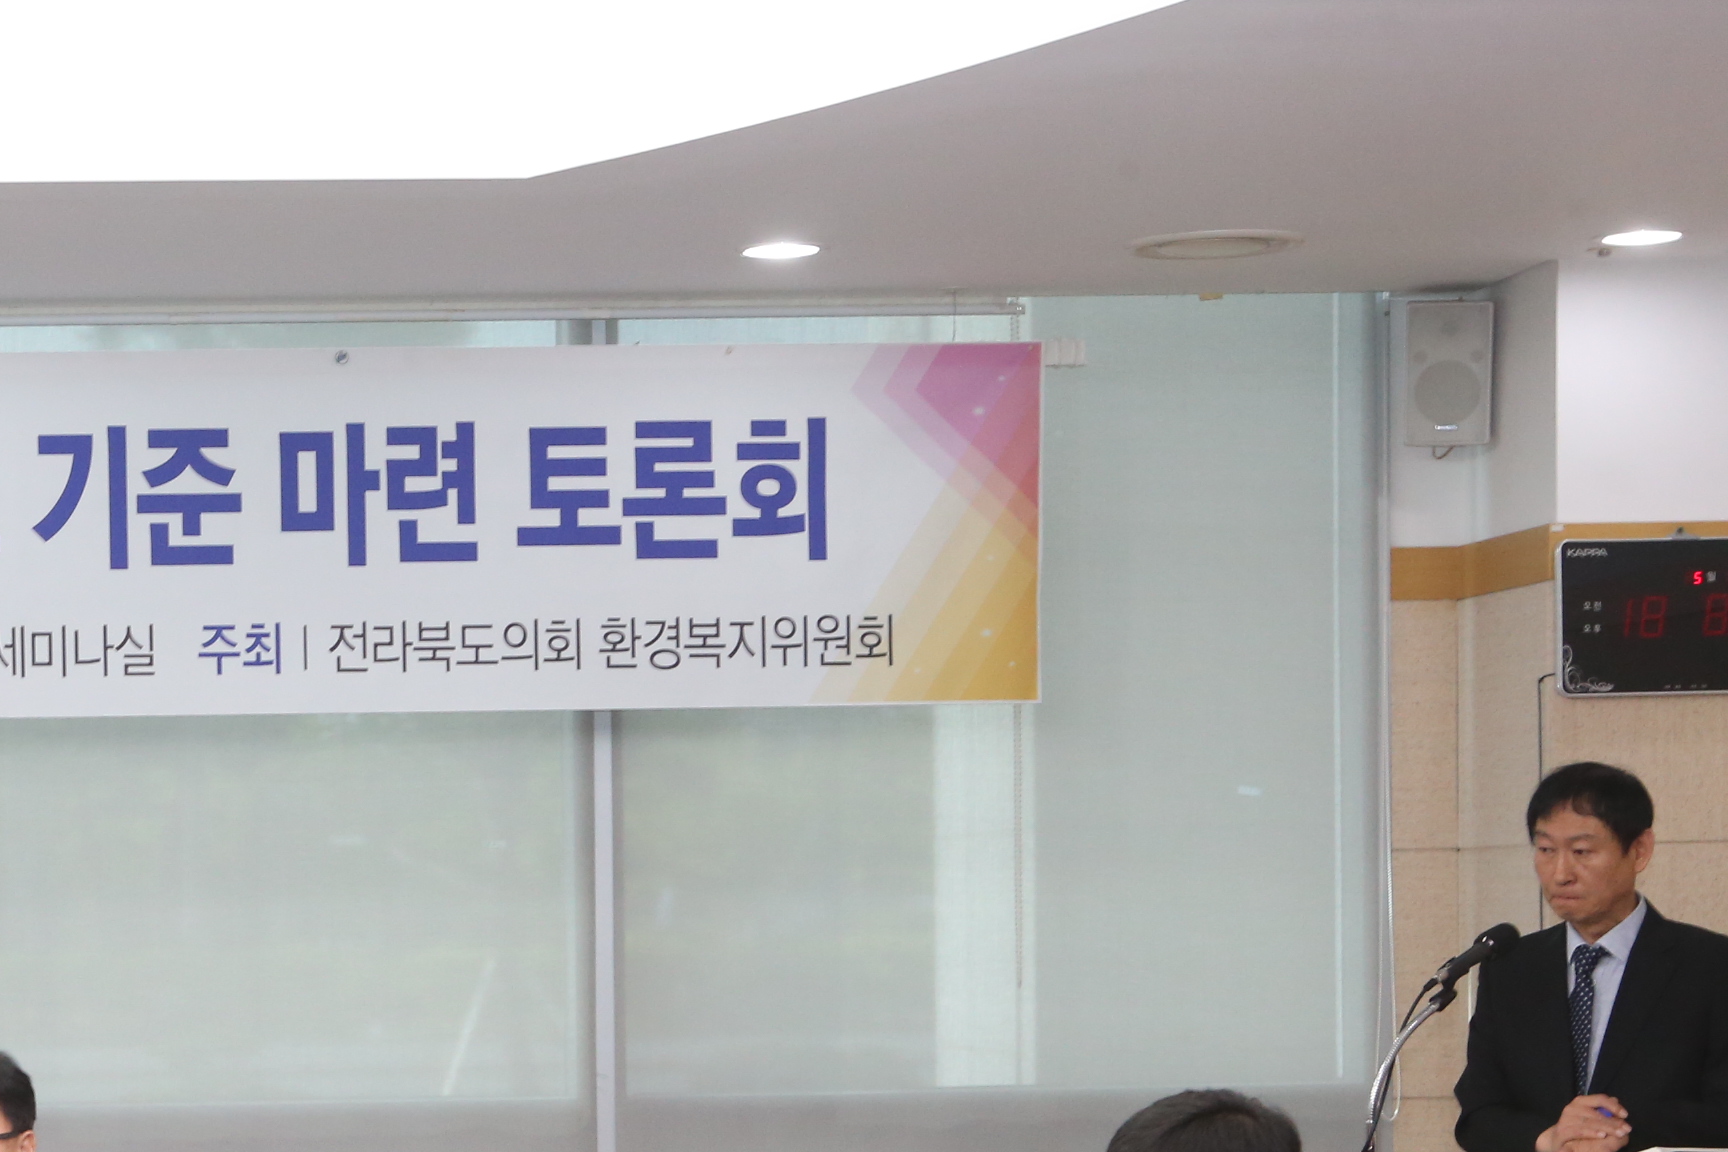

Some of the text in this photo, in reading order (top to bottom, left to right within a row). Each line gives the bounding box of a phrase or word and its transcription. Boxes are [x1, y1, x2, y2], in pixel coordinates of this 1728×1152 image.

[31, 424, 243, 571] 기준
[278, 420, 479, 567] 마련
[516, 416, 829, 562] 토론회
[1566, 548, 1608, 558] KAPPA
[197, 621, 282, 676] 주최
[328, 617, 582, 674] 전라북도의회
[598, 613, 894, 671] 환경복지위원회
